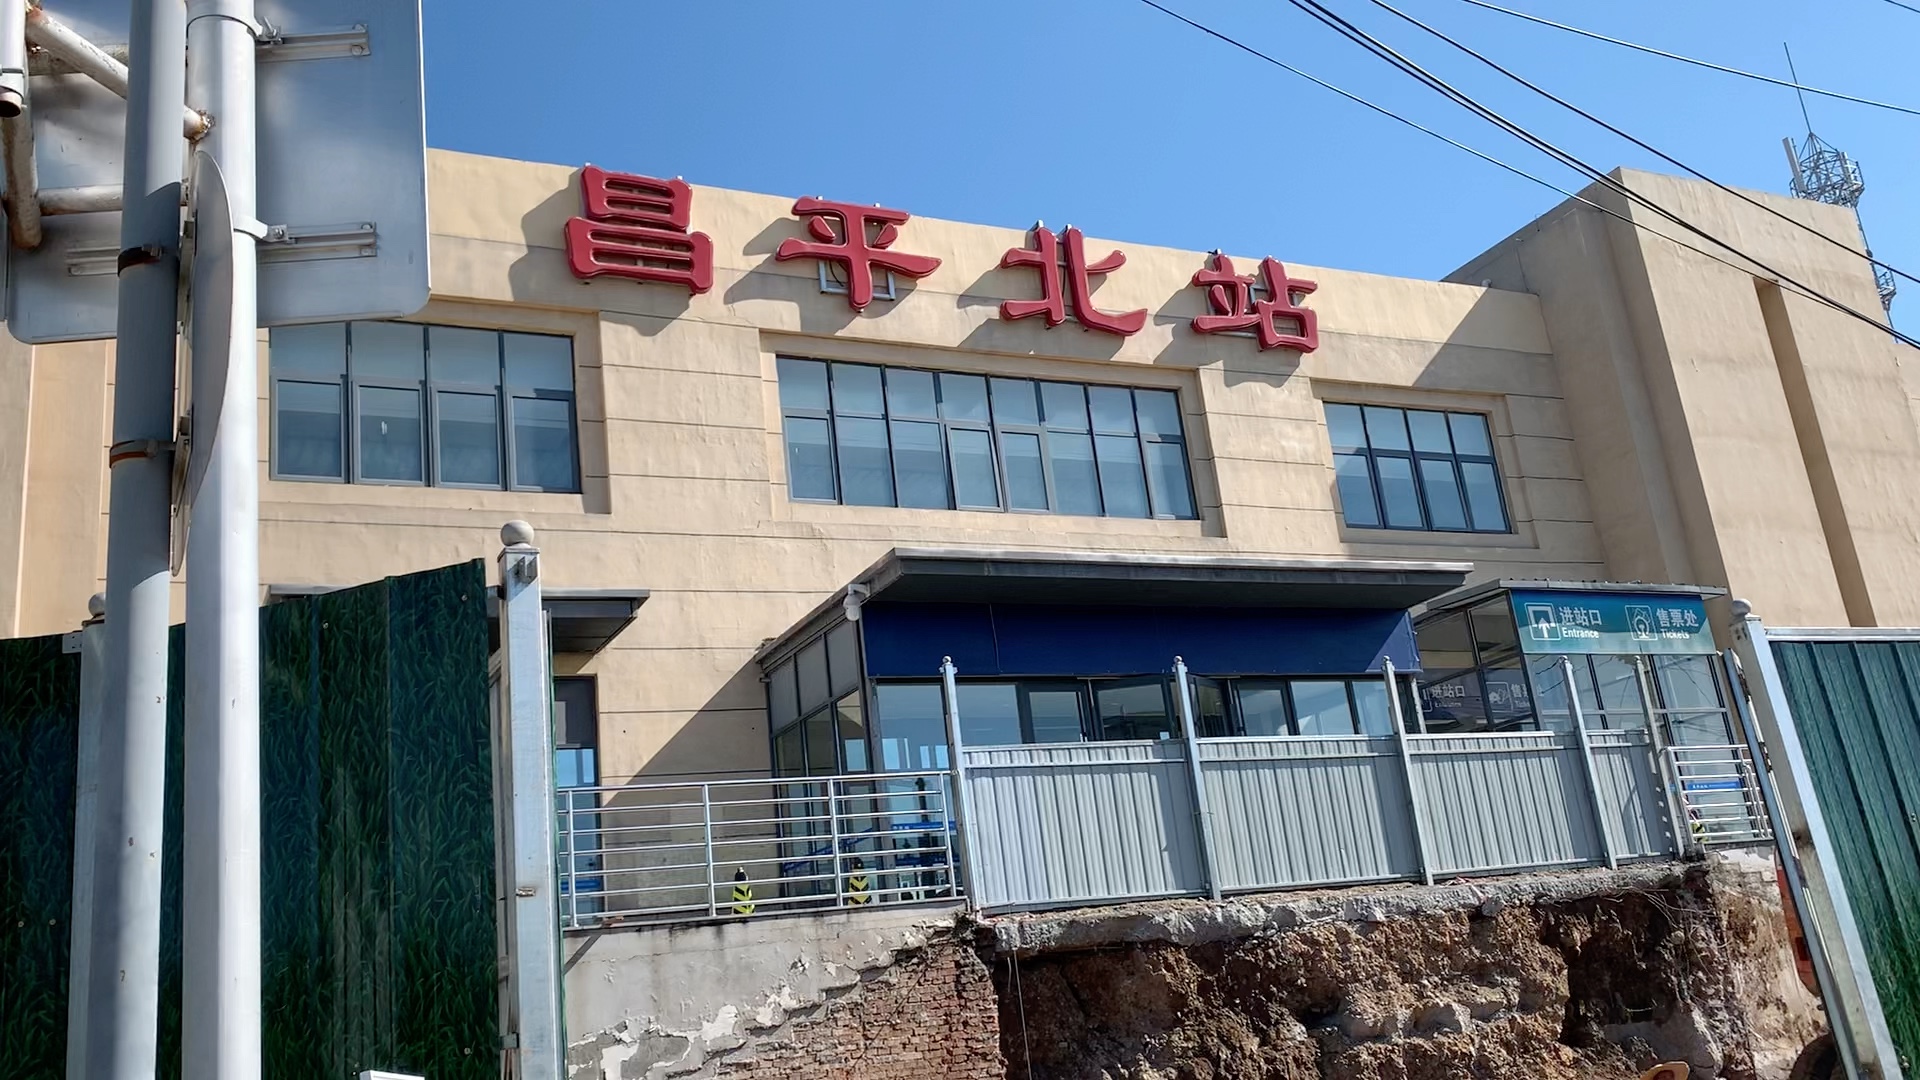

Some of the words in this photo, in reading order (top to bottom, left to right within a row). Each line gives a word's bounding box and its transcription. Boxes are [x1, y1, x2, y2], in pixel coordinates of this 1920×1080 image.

[565, 164, 1319, 354] 昌平北站
[1559, 606, 1602, 626] 进站口
[1656, 608, 1700, 628] 售票处
[1562, 628, 1600, 639] Entrance
[1661, 628, 1690, 640] Tickets
